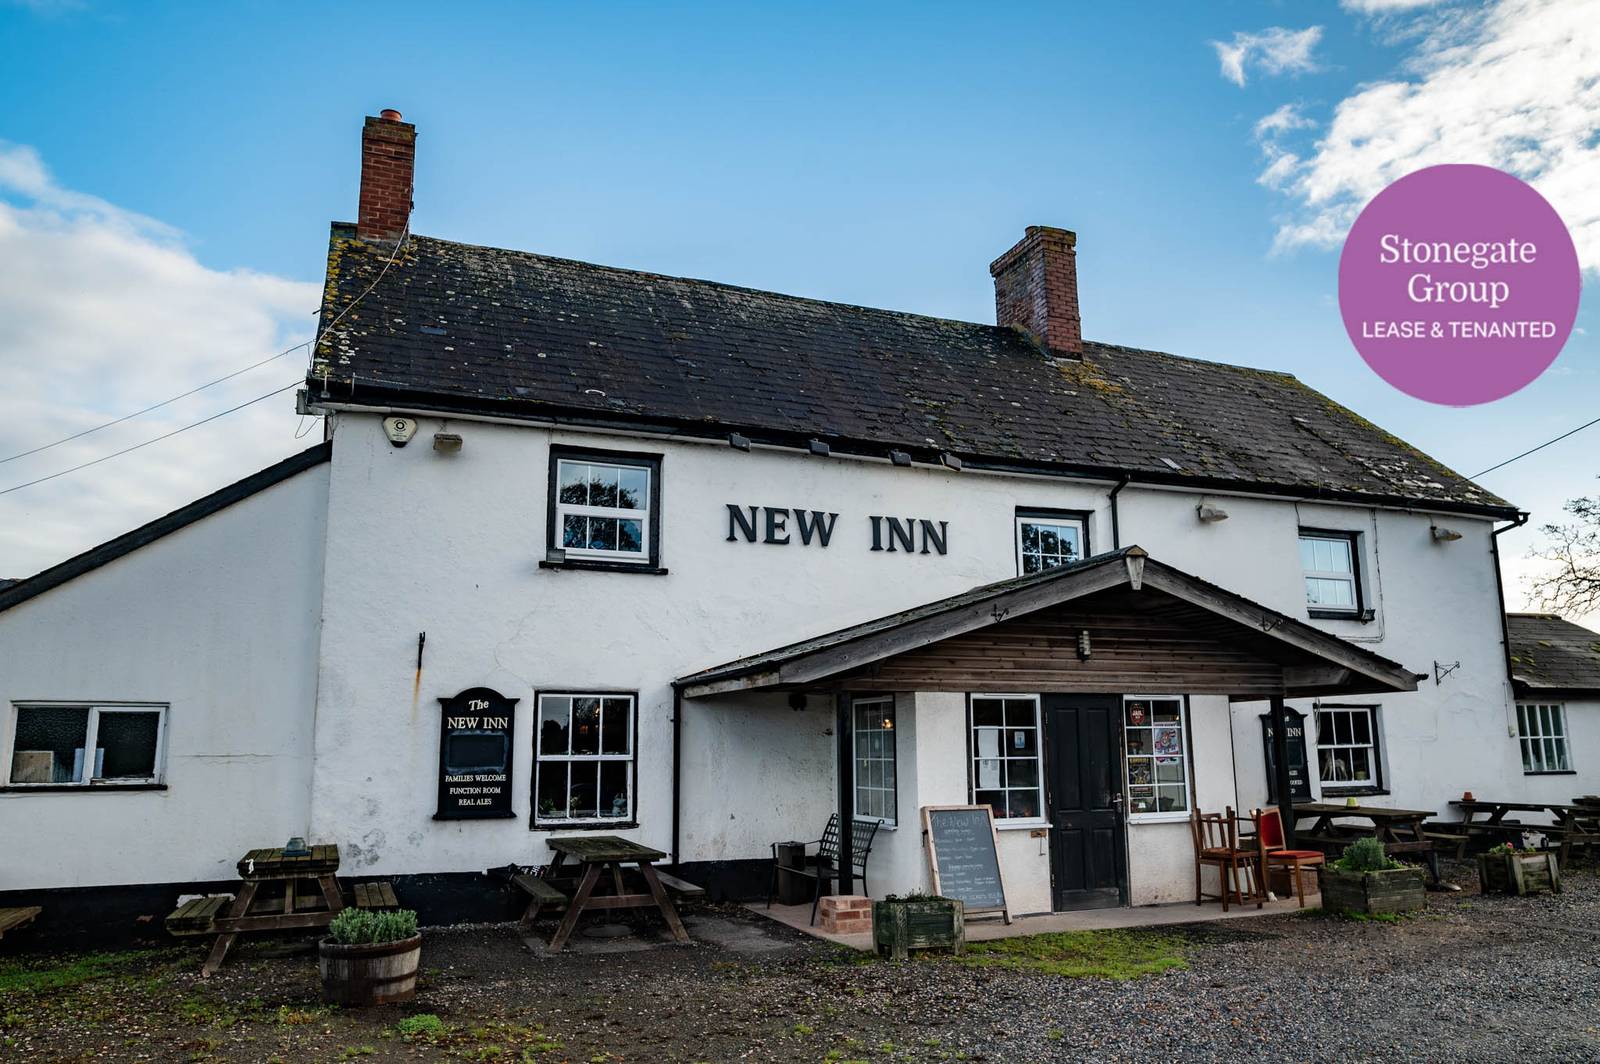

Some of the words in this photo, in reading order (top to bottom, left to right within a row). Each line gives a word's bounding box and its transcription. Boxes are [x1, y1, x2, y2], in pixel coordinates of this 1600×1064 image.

[726, 504, 839, 547] NEW
[869, 515, 949, 555] INN
[469, 699, 489, 711] The
[447, 716, 479, 729] NEW
[483, 716, 508, 729] INN
[1287, 727, 1302, 737] INN
[475, 774, 506, 782] WELCOME
[449, 787, 481, 795] FUNCTION
[458, 798, 475, 806] REAL
[476, 798, 492, 806] ALES
